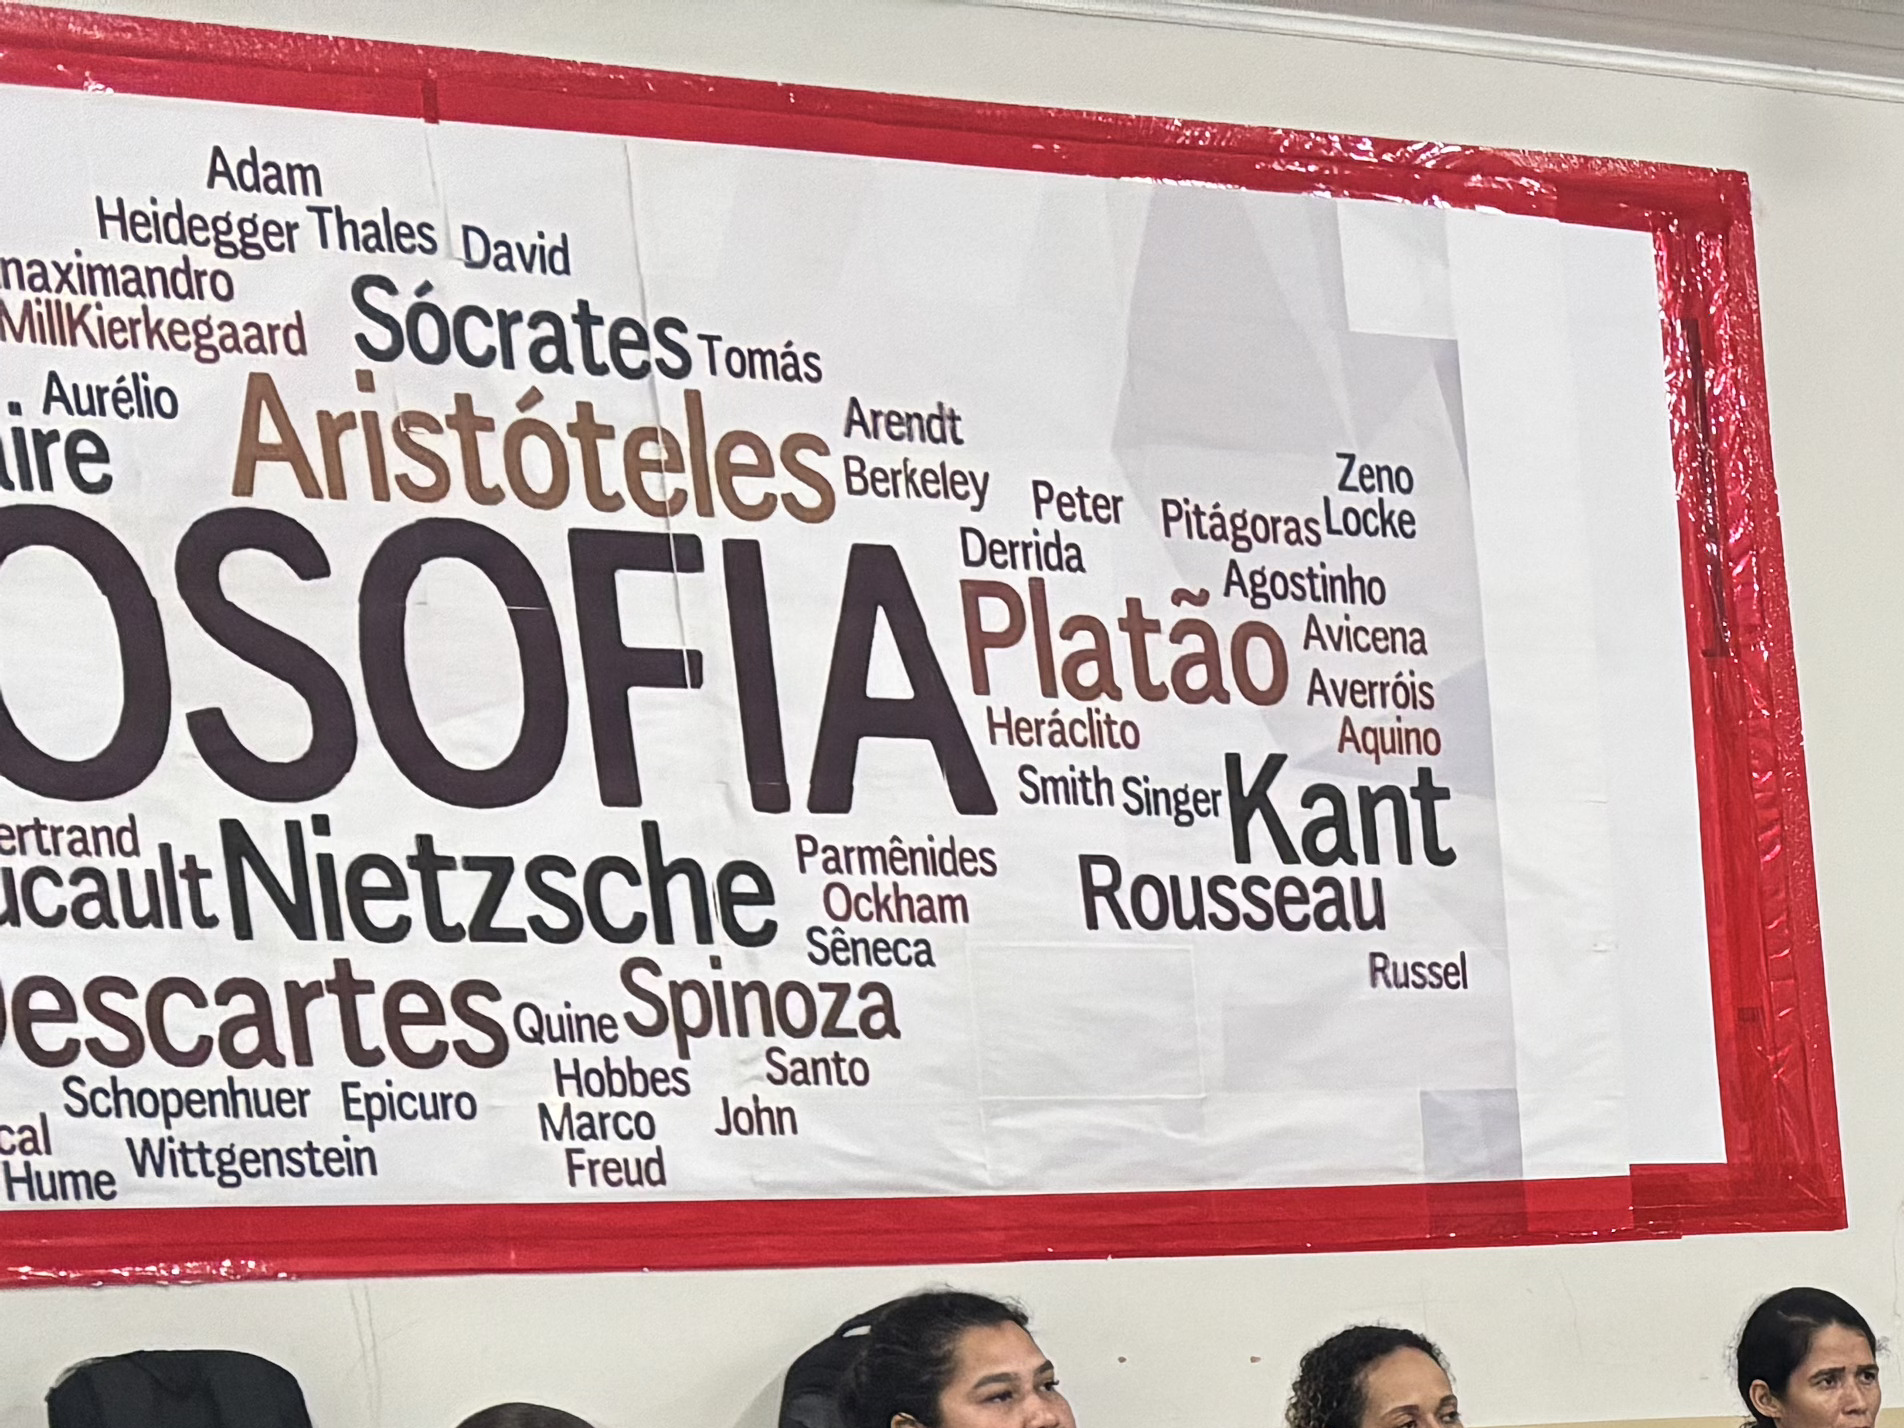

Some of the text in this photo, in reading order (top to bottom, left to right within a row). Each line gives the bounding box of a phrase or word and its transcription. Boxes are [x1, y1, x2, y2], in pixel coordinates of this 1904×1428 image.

[207, 146, 322, 197] Adam
[96, 196, 299, 260] Heidegger
[306, 205, 437, 255] Thales
[462, 225, 570, 276] David
[0, 248, 234, 302] naximandro
[351, 274, 692, 380] Sócrates
[697, 334, 822, 383] Tomás
[43, 370, 178, 420] Aurélio
[844, 396, 964, 445] Arendt
[231, 369, 836, 525] Aristóteles
[843, 455, 989, 512] Berkeley
[1336, 452, 1413, 495] Zeno
[1032, 480, 1124, 524] Peter
[1161, 498, 1321, 553] Pitágoras
[1323, 496, 1416, 539] Locke
[960, 527, 1086, 573] Derrida
[1223, 559, 1386, 609] Agostinho
[959, 571, 1289, 706] Platão
[1303, 613, 1428, 655] Avicena
[1307, 668, 1434, 710] Averróis
[987, 706, 1140, 749] Heráclito
[1338, 715, 1441, 765] Aquino
[1018, 764, 1114, 806] Smith
[1122, 775, 1222, 827] Singer
[1225, 753, 1456, 867] Kant
[219, 814, 778, 947] Nietzsche
[795, 834, 997, 877] Parmênides
[823, 881, 969, 923] Ockham
[1079, 854, 1386, 931] Rousseau
[806, 926, 936, 967] Sêneca
[1369, 951, 1468, 989] Russel
[0, 958, 509, 1069] escartes
[513, 1001, 619, 1045] Quine
[620, 955, 901, 1060] Spinoza
[554, 1056, 691, 1098] Hobbes
[766, 1046, 869, 1086] Santo
[63, 1075, 311, 1130] Schopenhuer
[341, 1079, 477, 1133] Epicuro
[538, 1102, 655, 1141] Marco
[715, 1094, 798, 1136] John
[2, 1161, 117, 1201] Hume
[125, 1135, 377, 1188] Wittgenstein
[565, 1145, 666, 1187] Freud
